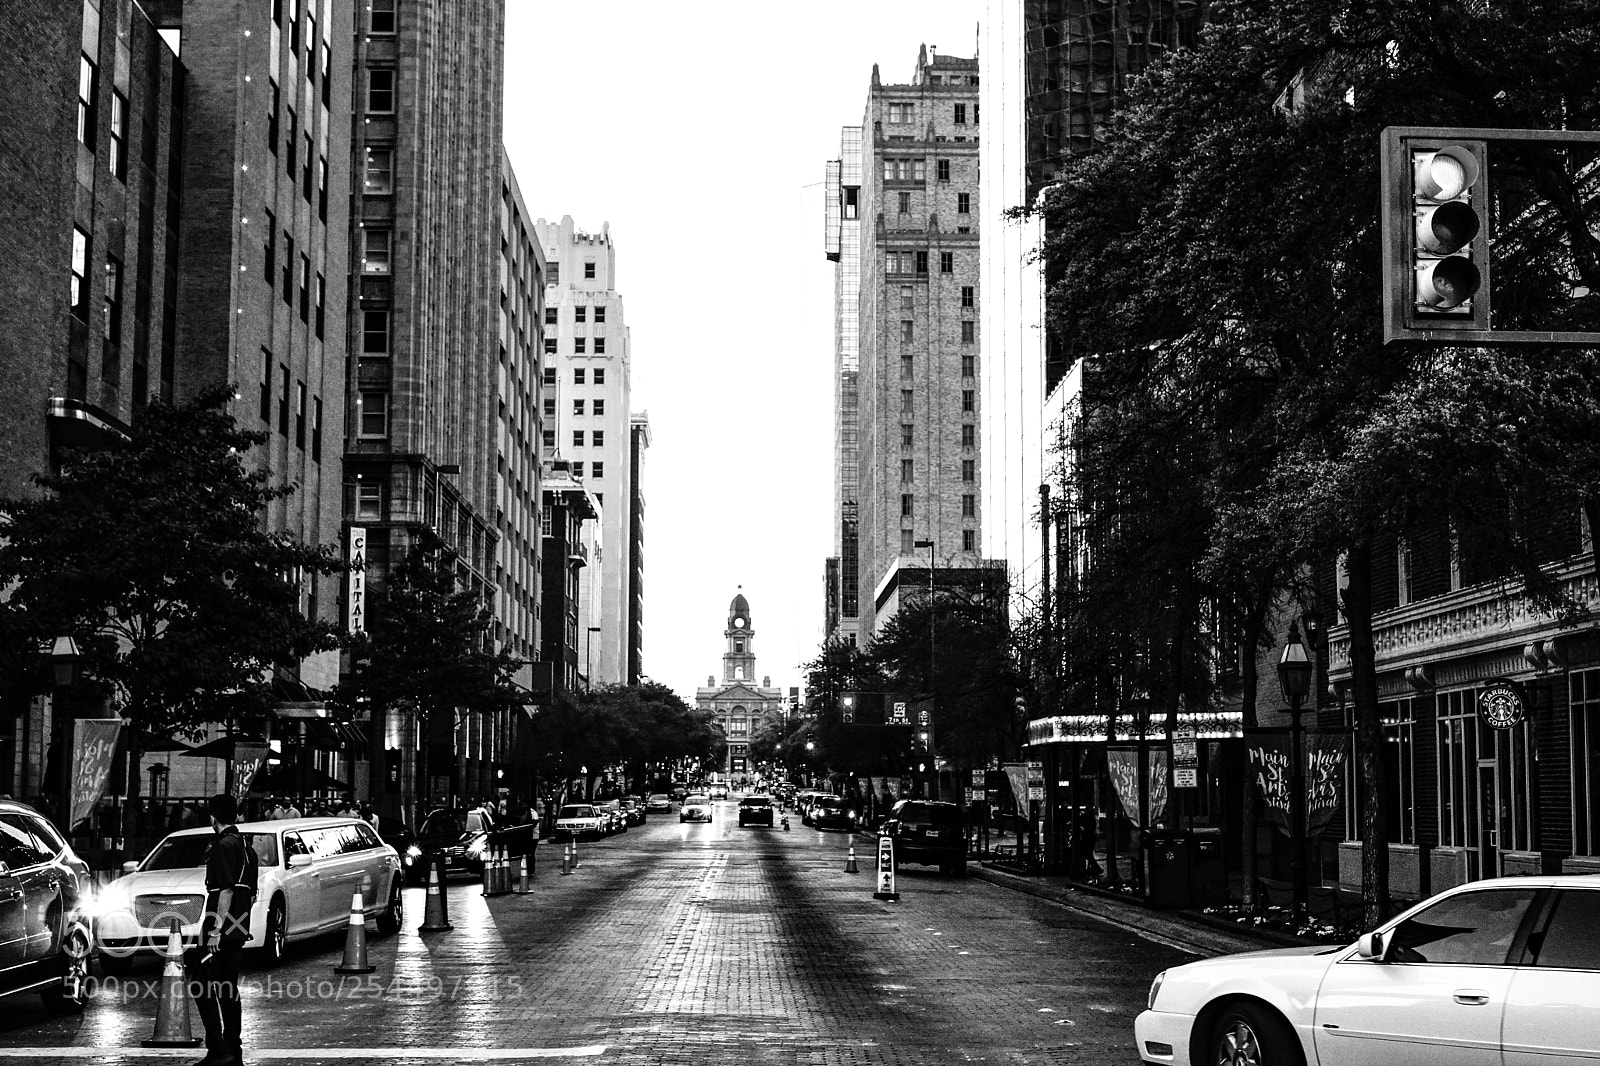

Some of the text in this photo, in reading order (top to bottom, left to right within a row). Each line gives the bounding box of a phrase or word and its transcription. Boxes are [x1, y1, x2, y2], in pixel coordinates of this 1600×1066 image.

[1482, 688, 1520, 707] STARBUCKS
[1488, 716, 1517, 728] COFFEE
[1248, 747, 1290, 768] Main
[1308, 749, 1343, 771] Main
